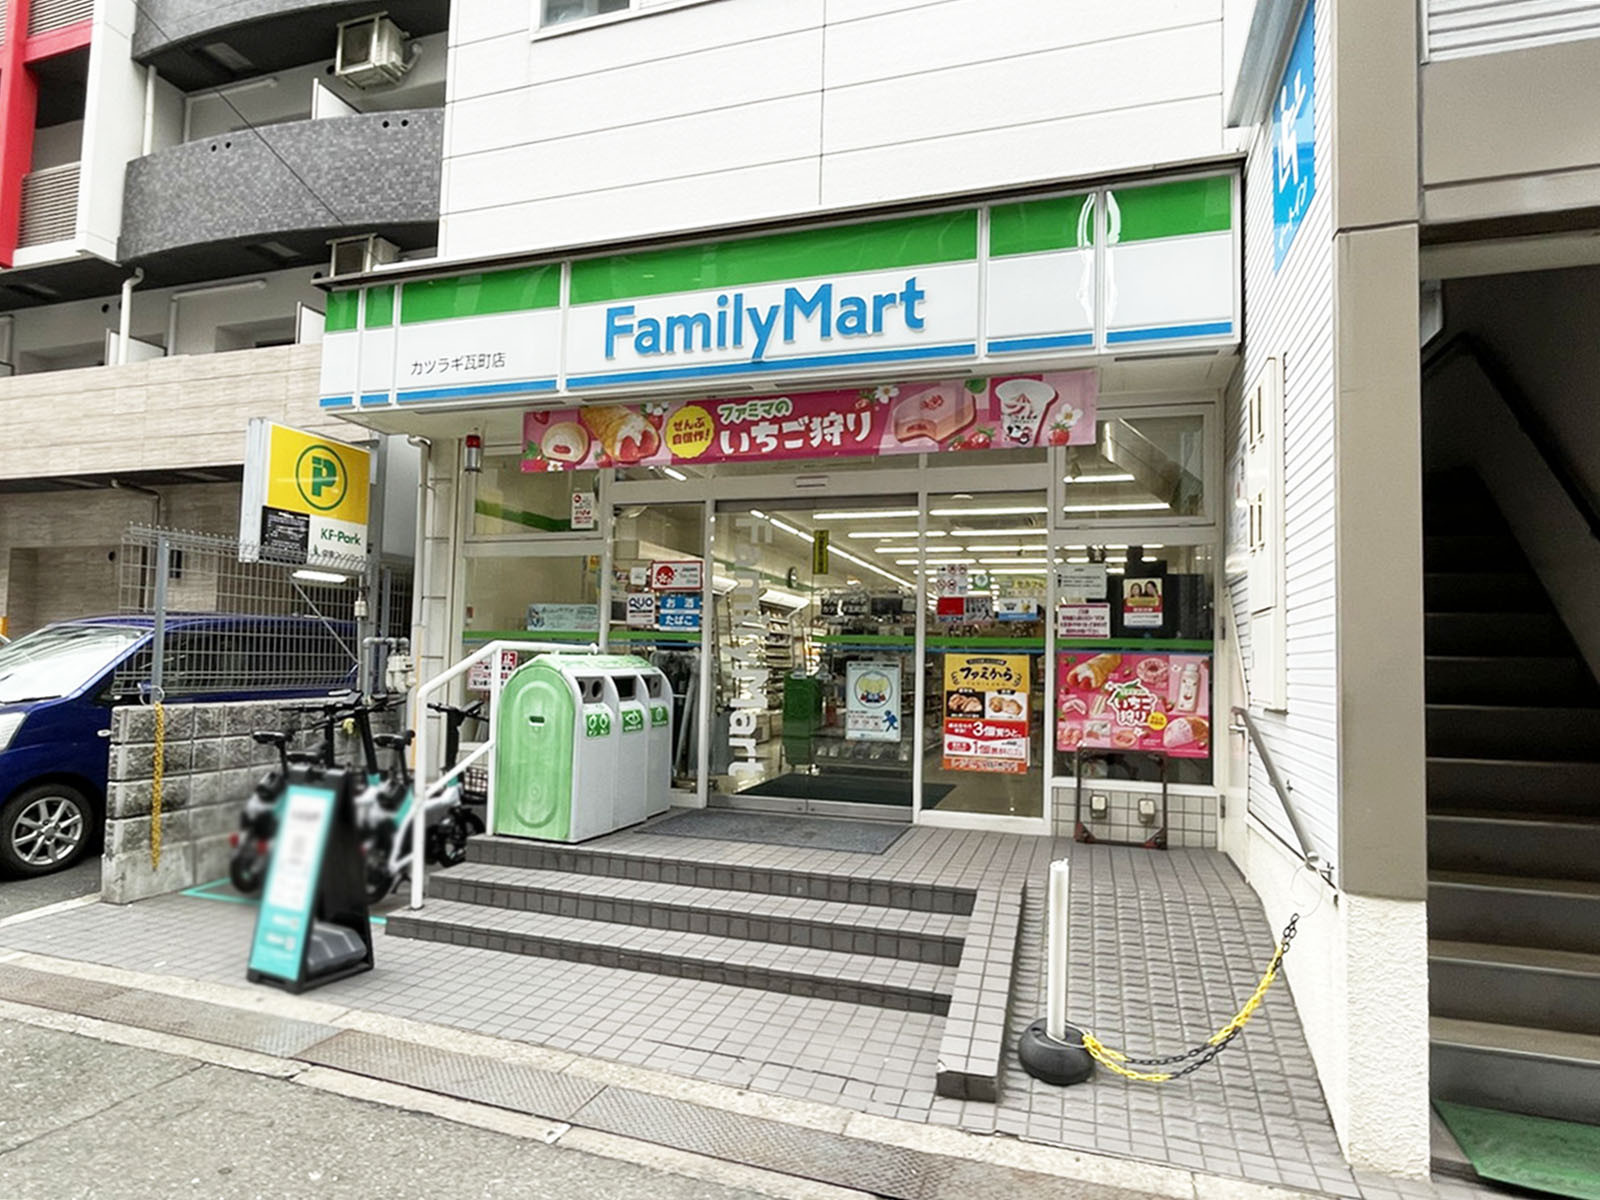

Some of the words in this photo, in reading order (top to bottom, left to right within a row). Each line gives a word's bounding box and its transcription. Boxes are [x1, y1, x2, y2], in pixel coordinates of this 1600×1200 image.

[605, 277, 925, 363] FamilyMart
[411, 352, 506, 375] カツラギ瓦町店
[719, 398, 791, 424] ファミマの
[673, 416, 706, 432] ぜんぶ
[720, 411, 872, 454] いちご狩り
[320, 527, 361, 546] KF-Park
[628, 597, 654, 610] QUO
[665, 615, 694, 626] たばこ
